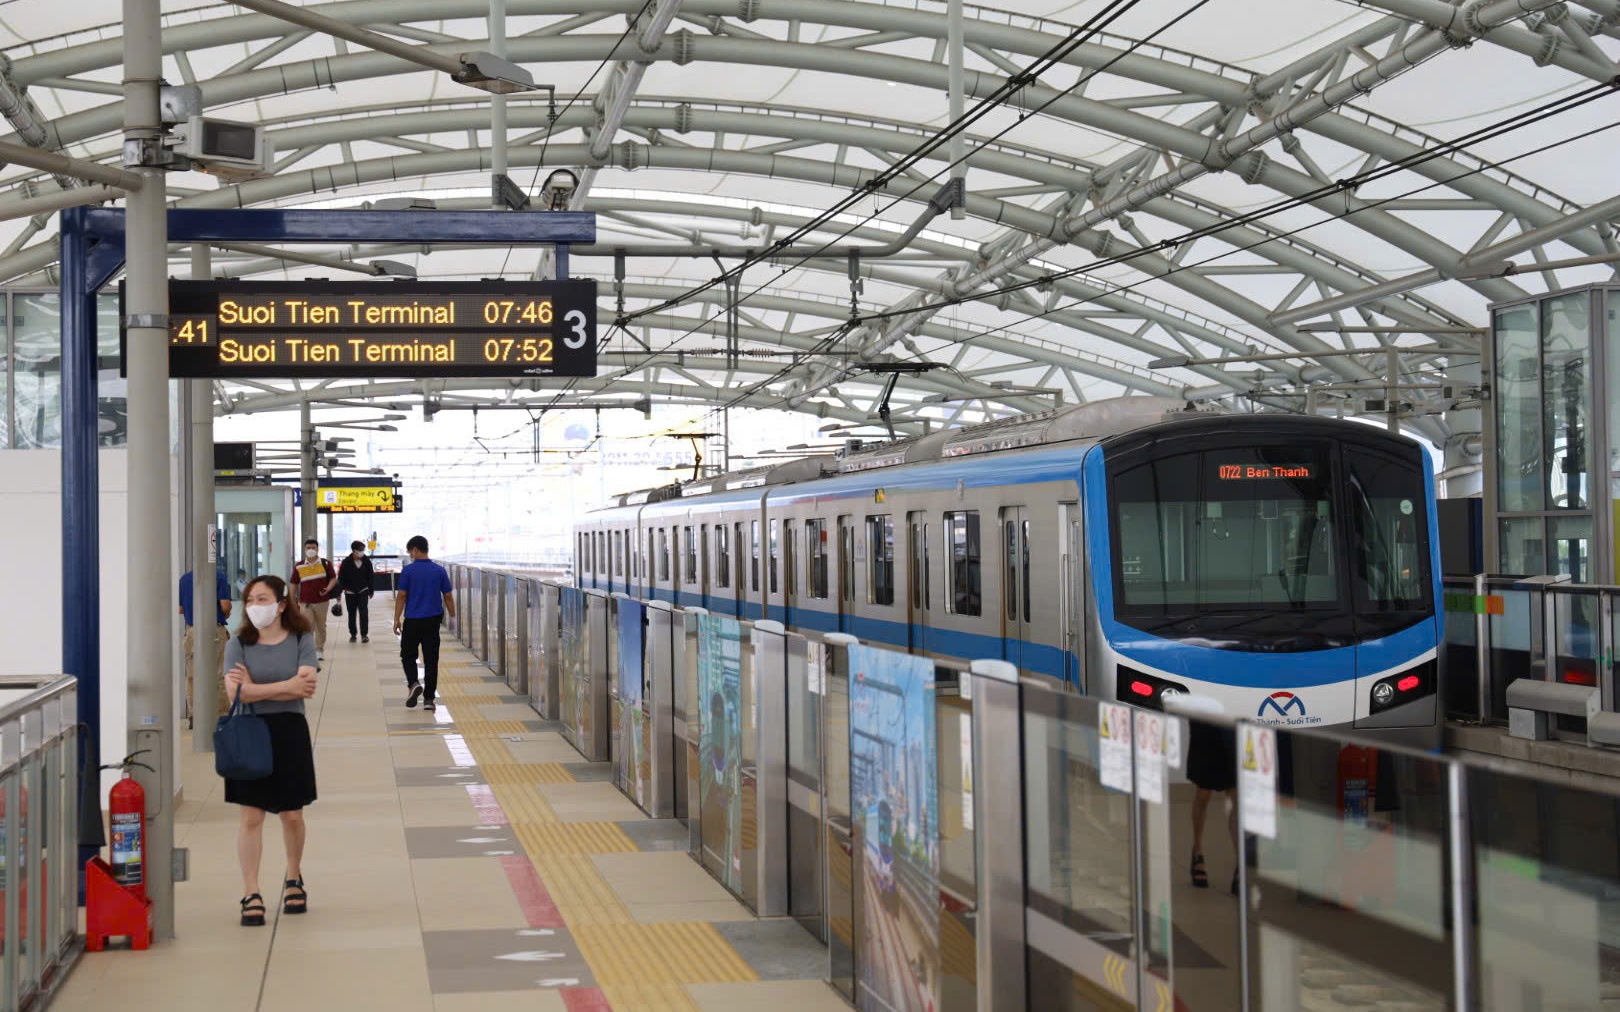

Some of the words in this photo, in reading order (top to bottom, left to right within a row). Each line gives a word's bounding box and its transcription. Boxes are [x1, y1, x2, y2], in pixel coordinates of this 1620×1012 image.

[219, 301, 275, 324] Suoi
[285, 301, 340, 324] Tien
[348, 301, 455, 324] Terminal
[484, 301, 553, 324] 07:46
[172, 320, 208, 343] :41
[563, 310, 587, 350] 3
[219, 339, 276, 362] Suoi
[285, 339, 340, 362] Tien
[348, 339, 455, 362] Terminal
[484, 339, 553, 362] 07:52
[1219, 465, 1241, 478] 0722
[1246, 467, 1269, 477] Ben
[1272, 466, 1309, 477] Thanh
[339, 490, 360, 498] Thang
